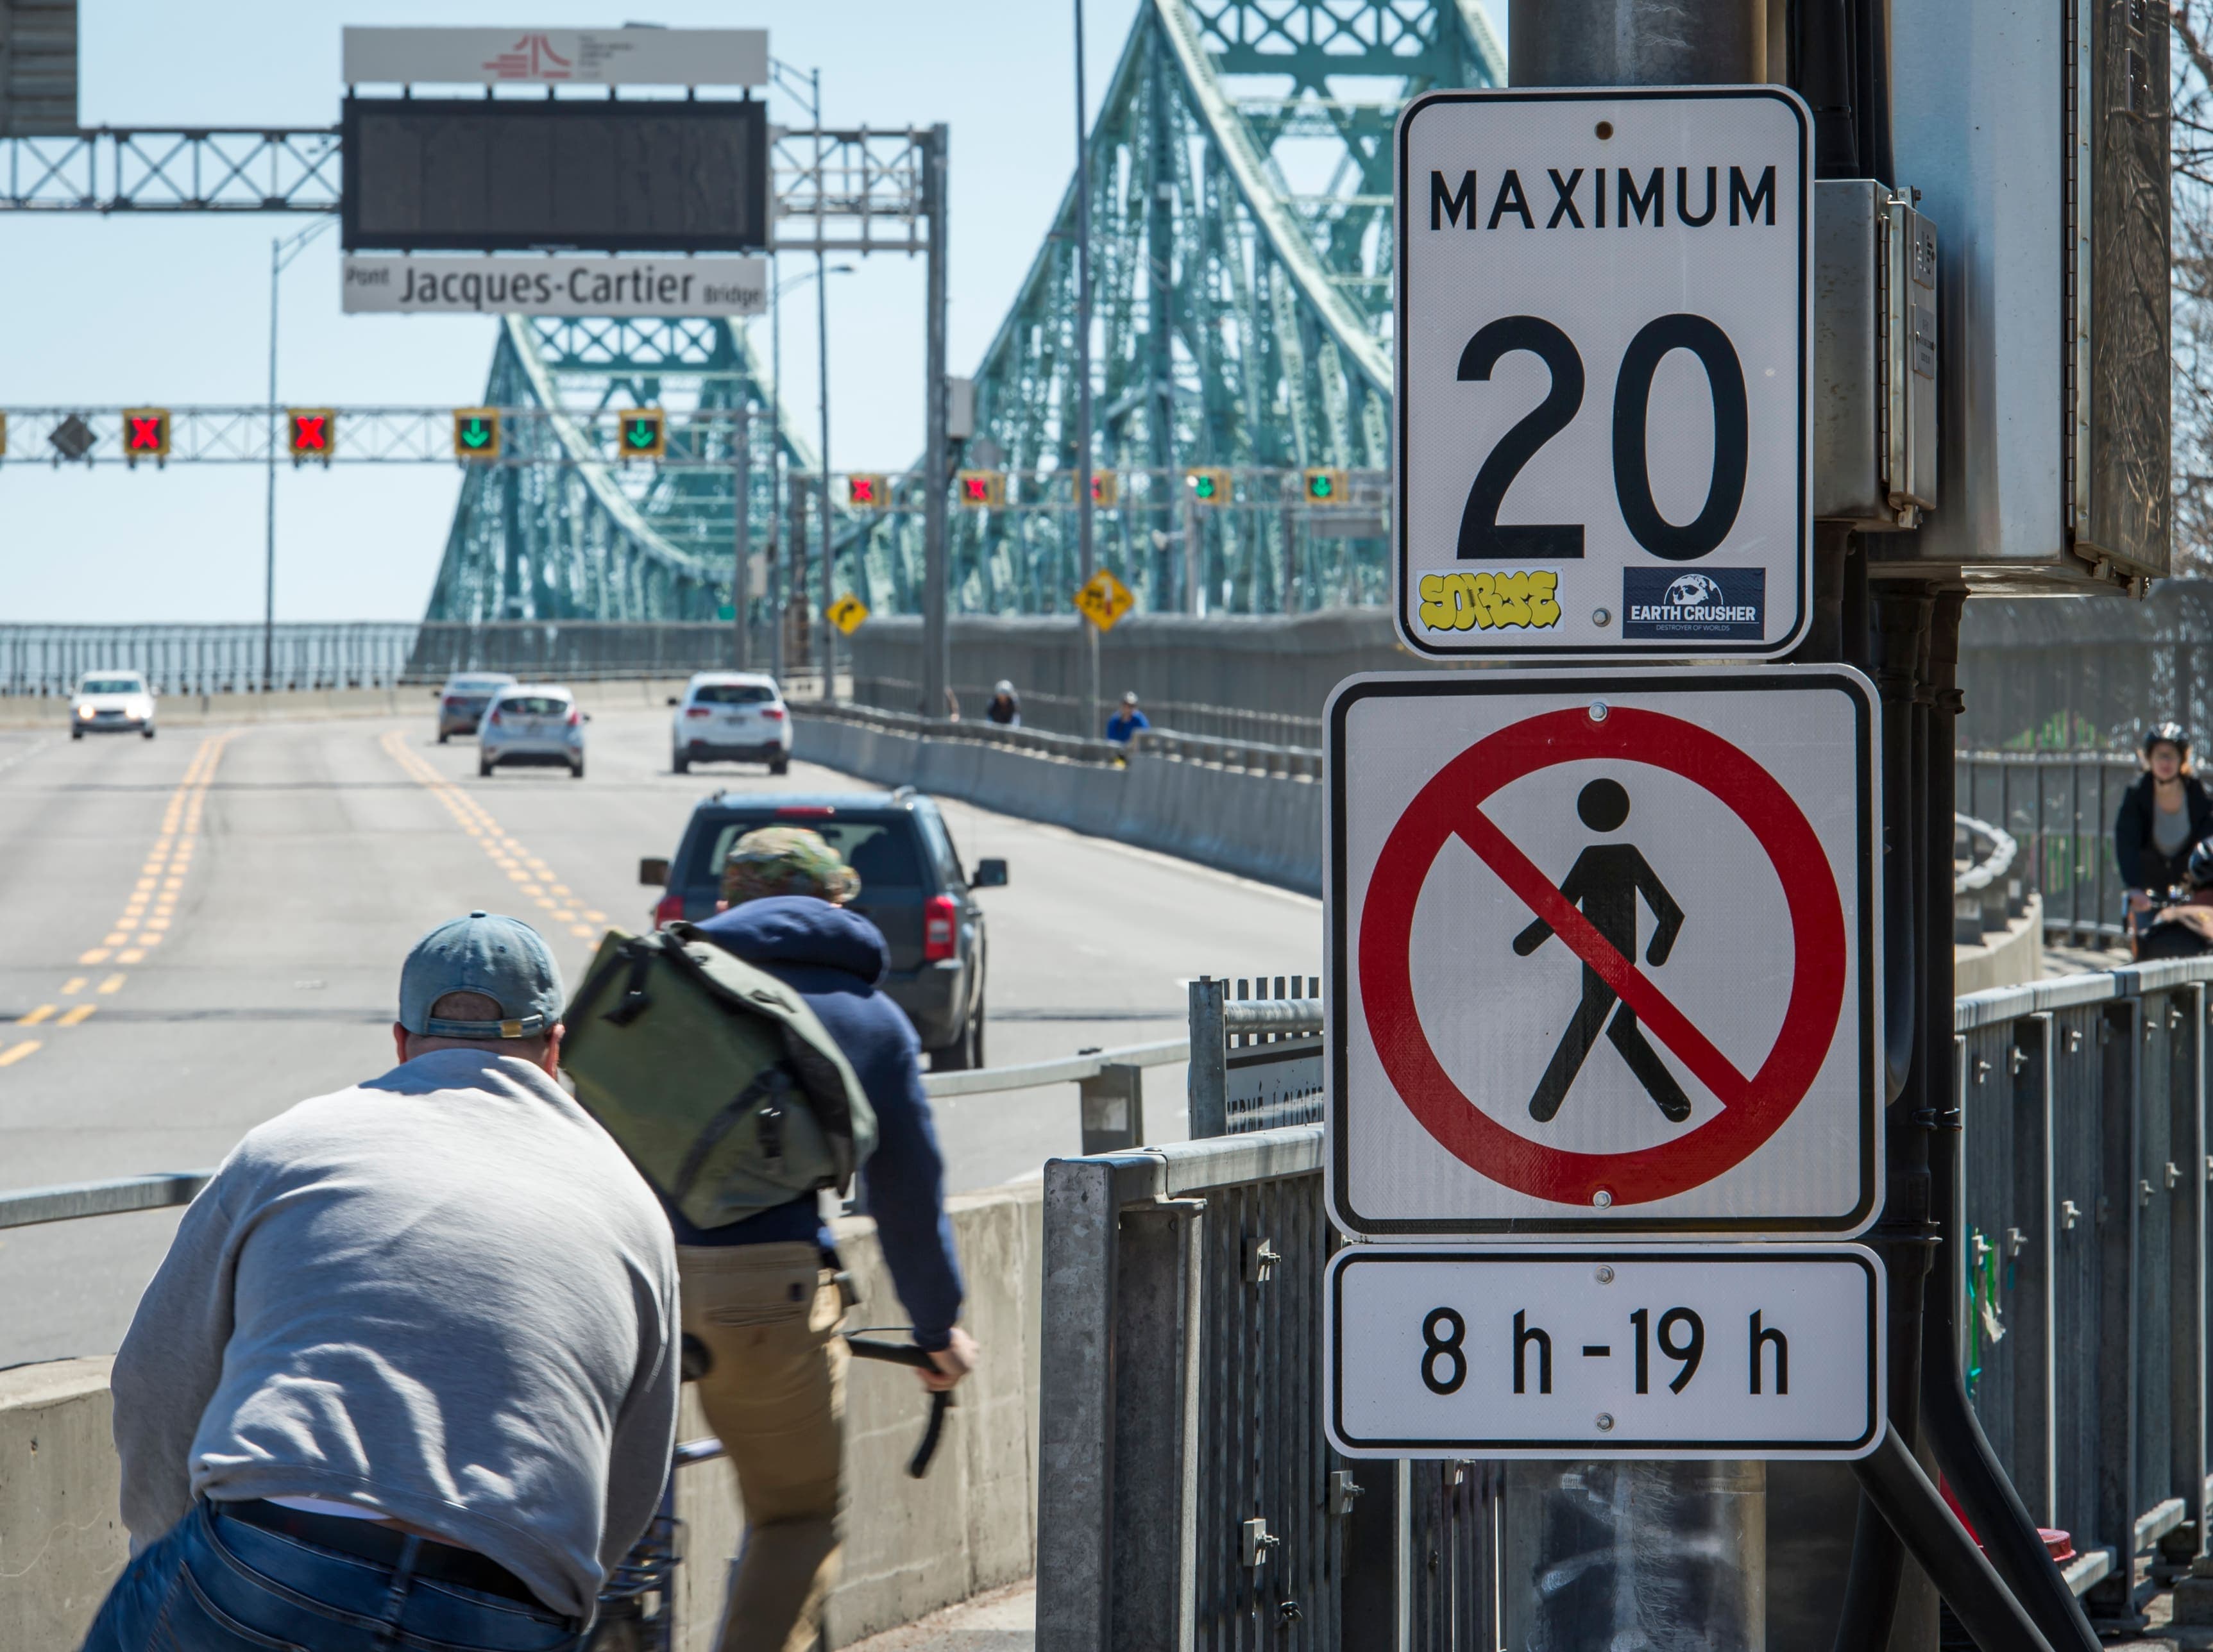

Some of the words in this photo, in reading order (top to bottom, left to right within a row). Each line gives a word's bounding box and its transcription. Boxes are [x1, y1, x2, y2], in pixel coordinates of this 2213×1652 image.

[1430, 165, 1776, 231] MAXIMUM
[345, 266, 390, 286] Pont
[398, 265, 695, 311] Jacques-Cartier
[703, 284, 759, 309] Bridge
[1456, 312, 1749, 561] 20
[1631, 605, 1681, 621] EARTH
[1683, 606, 1756, 621] CRUSHER
[1421, 1306, 1468, 1396] 8
[1749, 1308, 1788, 1395] h
